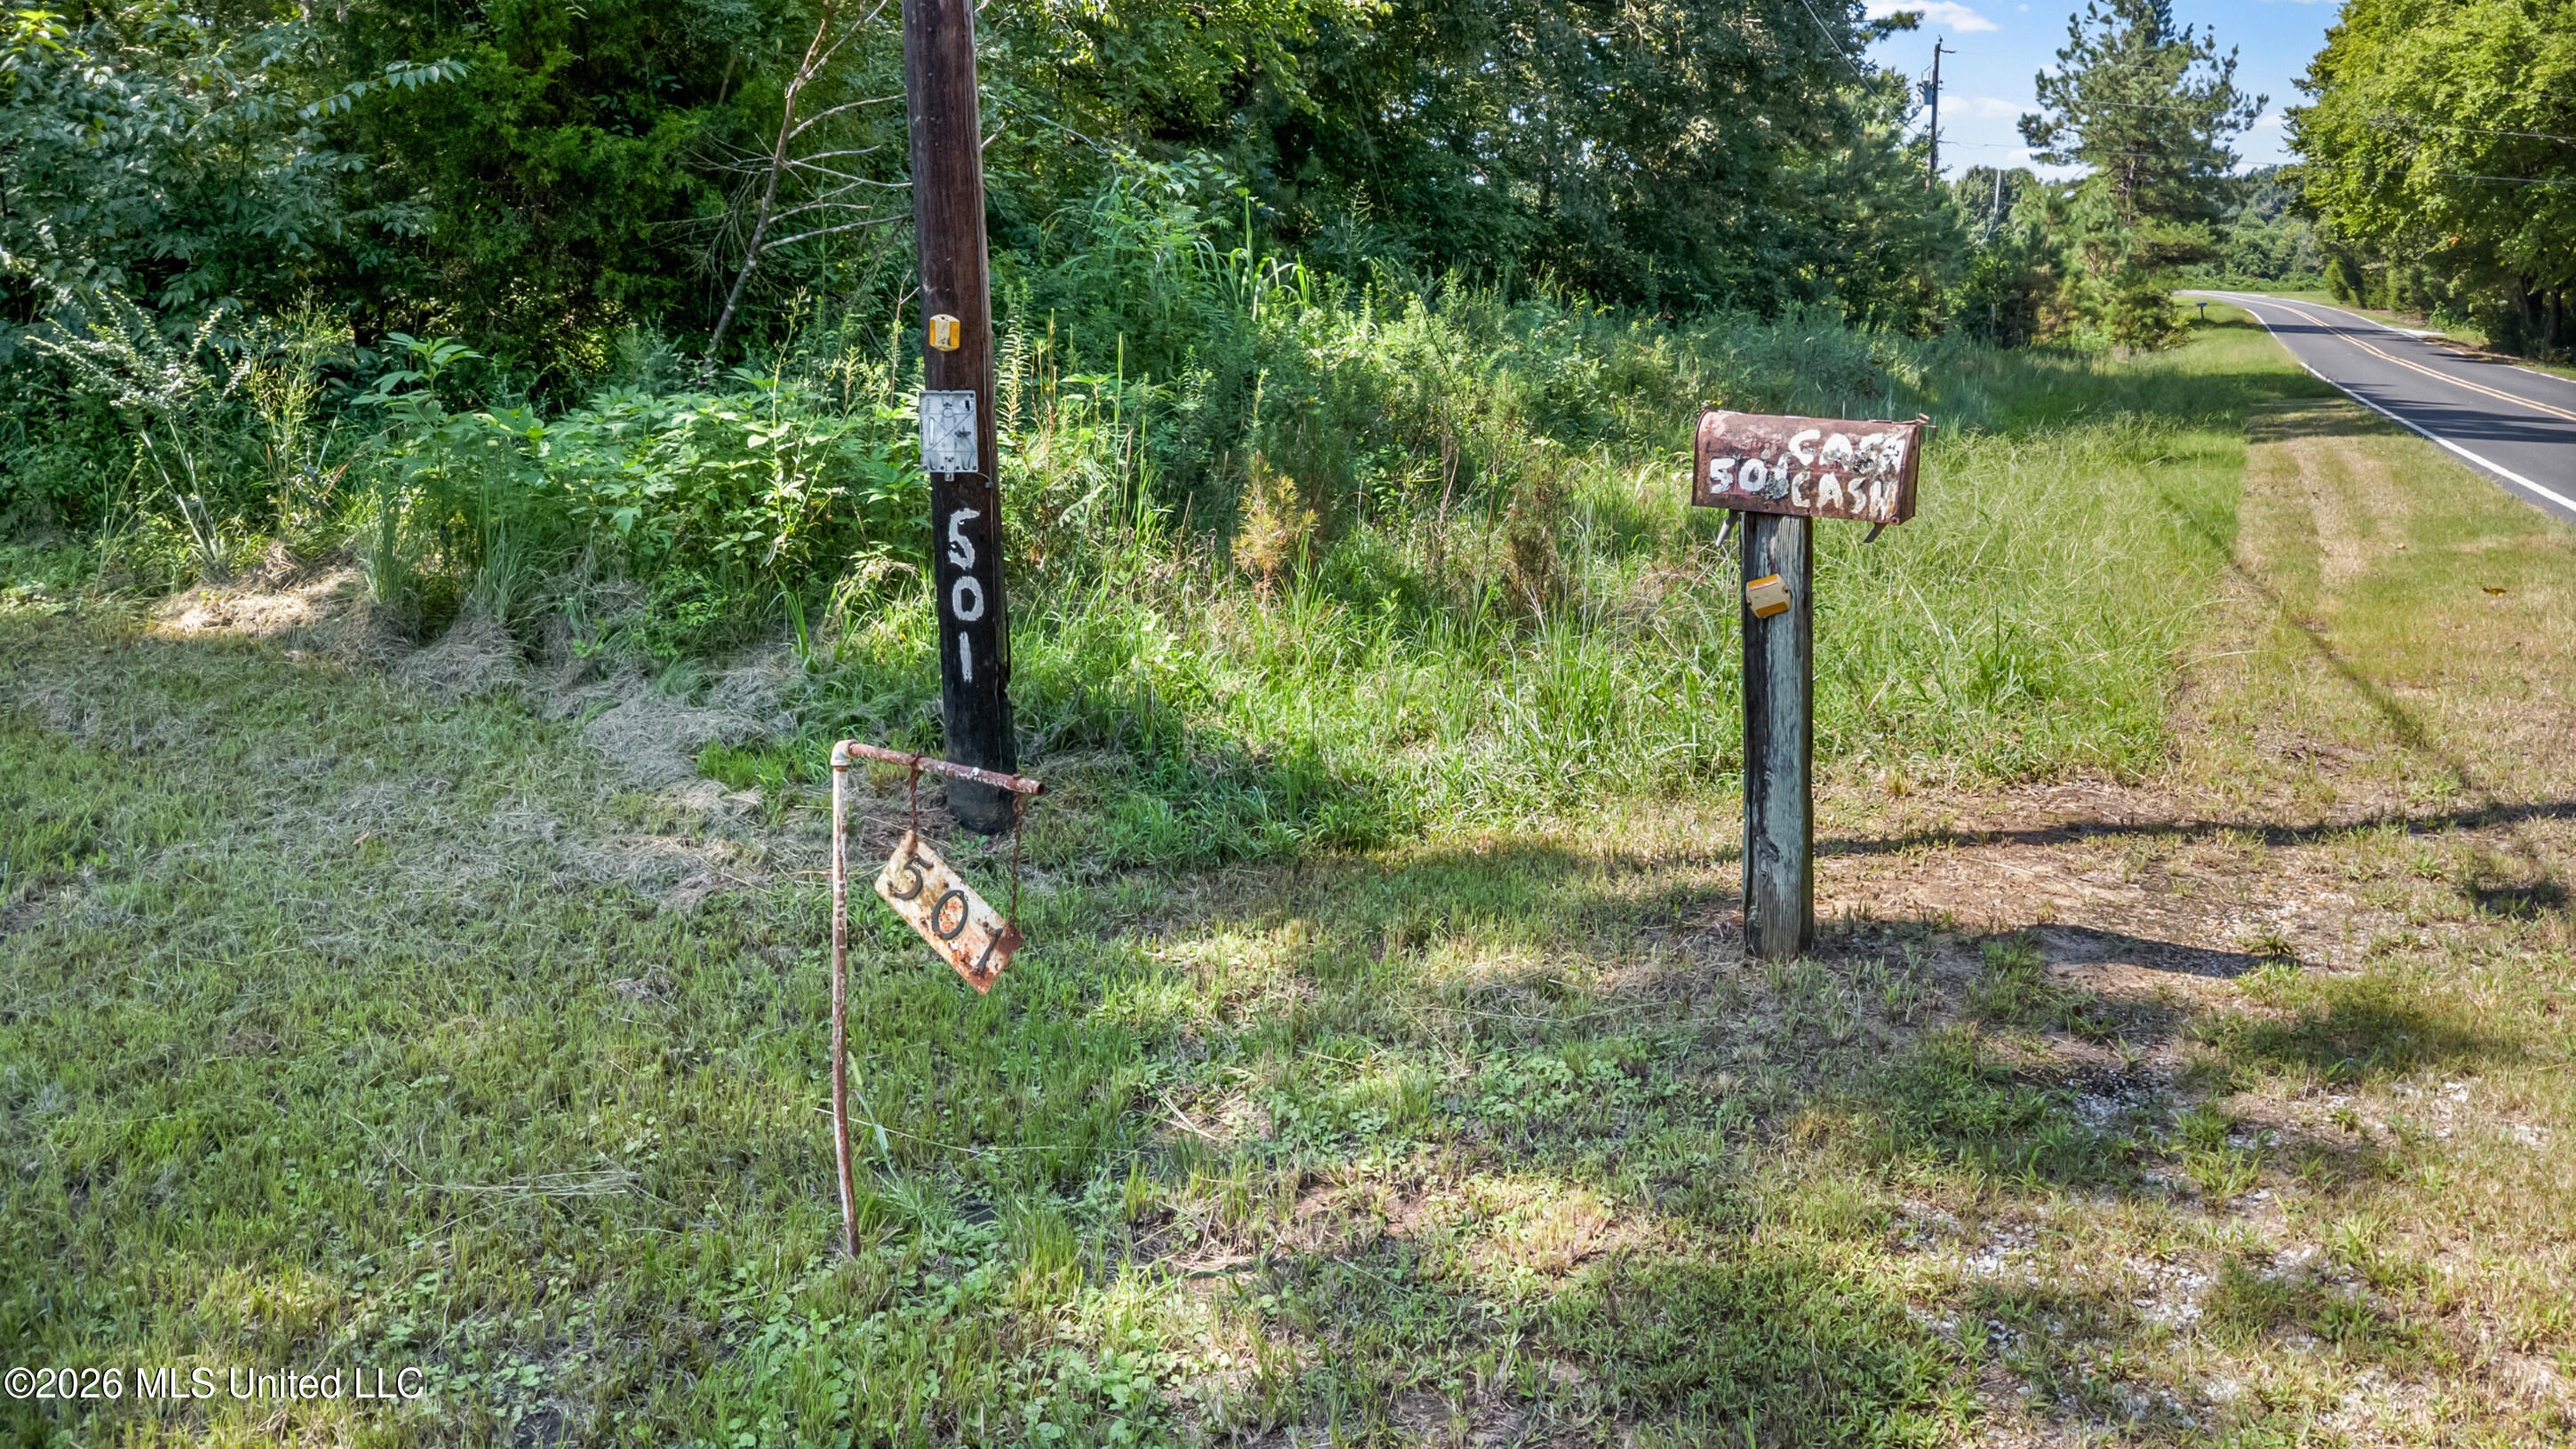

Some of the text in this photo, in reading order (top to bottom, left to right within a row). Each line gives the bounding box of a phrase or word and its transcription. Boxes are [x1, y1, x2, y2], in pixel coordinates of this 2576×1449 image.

[1791, 471, 1899, 521] CASH
[947, 506, 985, 683] 501
[888, 852, 1004, 975] 501
